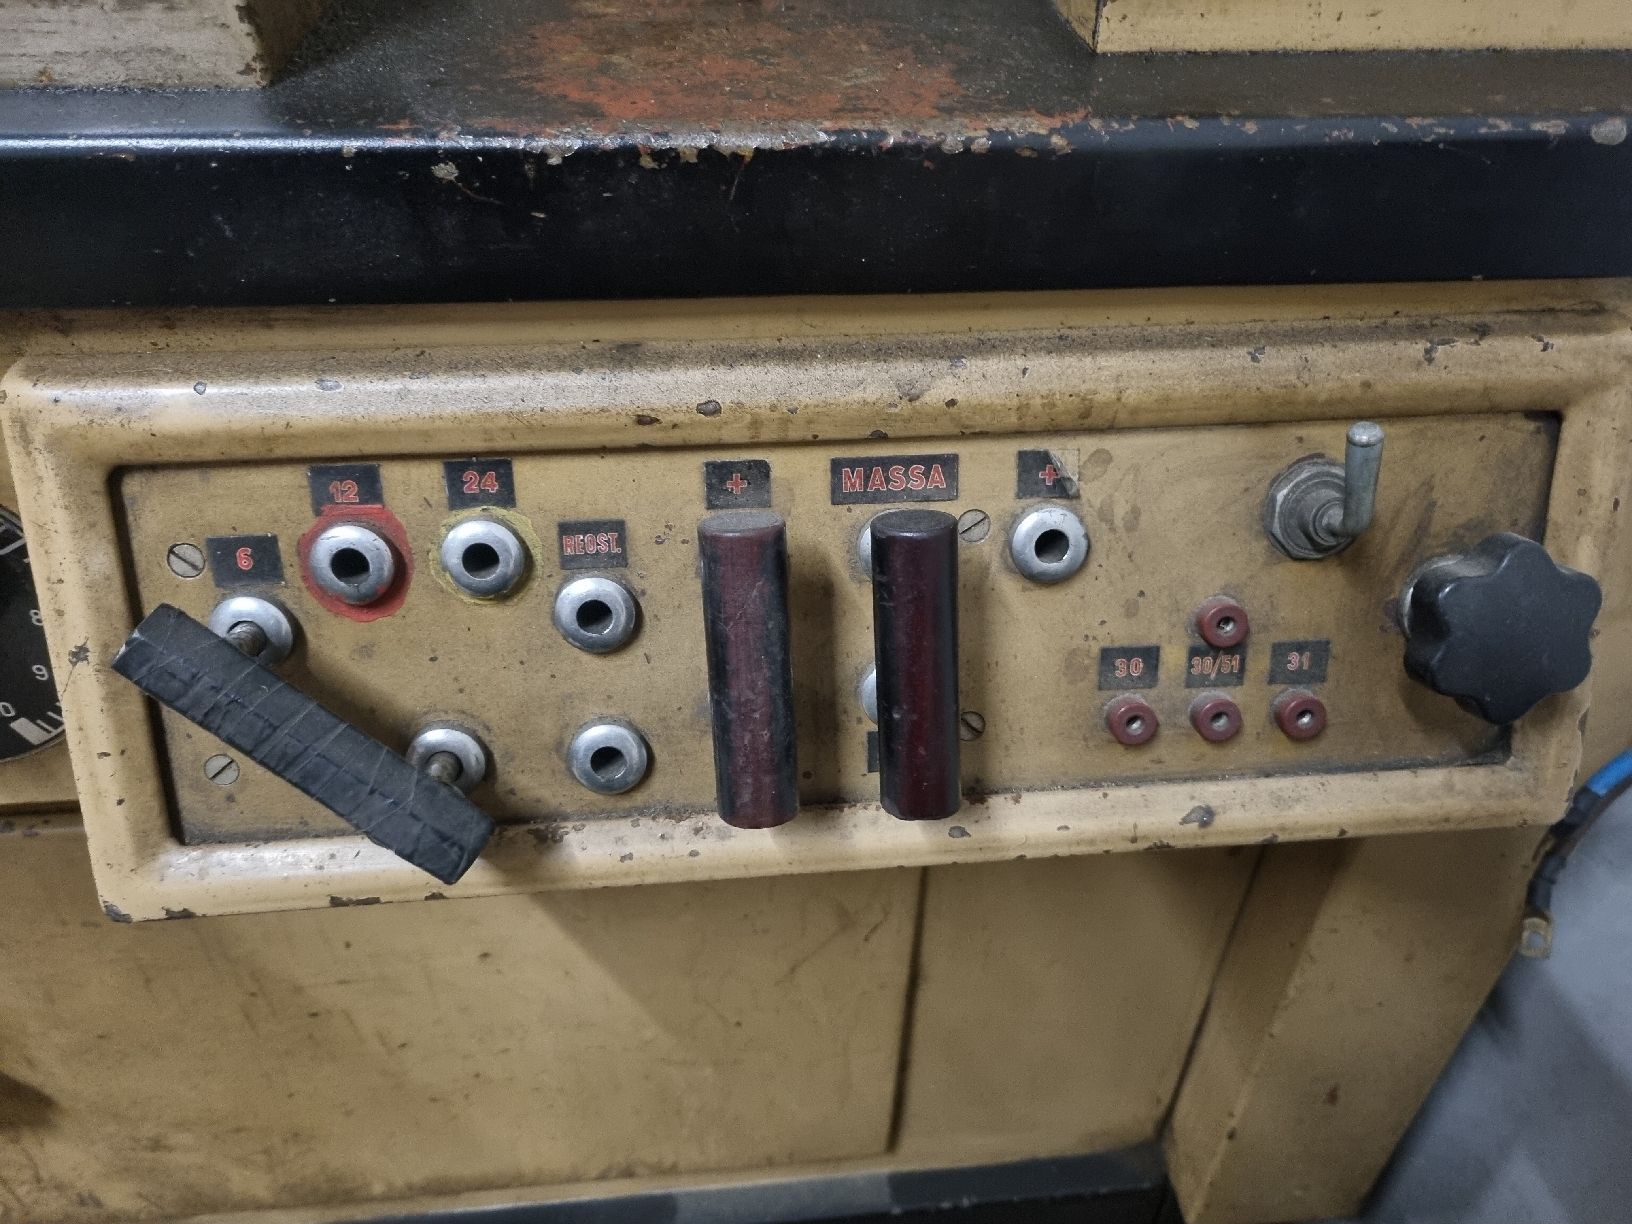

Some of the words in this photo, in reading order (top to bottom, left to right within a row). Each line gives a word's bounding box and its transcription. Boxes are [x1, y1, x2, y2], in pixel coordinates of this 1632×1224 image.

[462, 470, 499, 494] 24
[842, 464, 947, 493] MASSA
[329, 480, 359, 503] 12
[562, 532, 622, 556] REOST.
[236, 547, 254, 571] 6
[29, 609, 44, 626] 8
[32, 664, 49, 681] 9
[1115, 657, 1144, 678] 30
[1191, 649, 1240, 680] 30/51
[1287, 651, 1310, 671] 31
